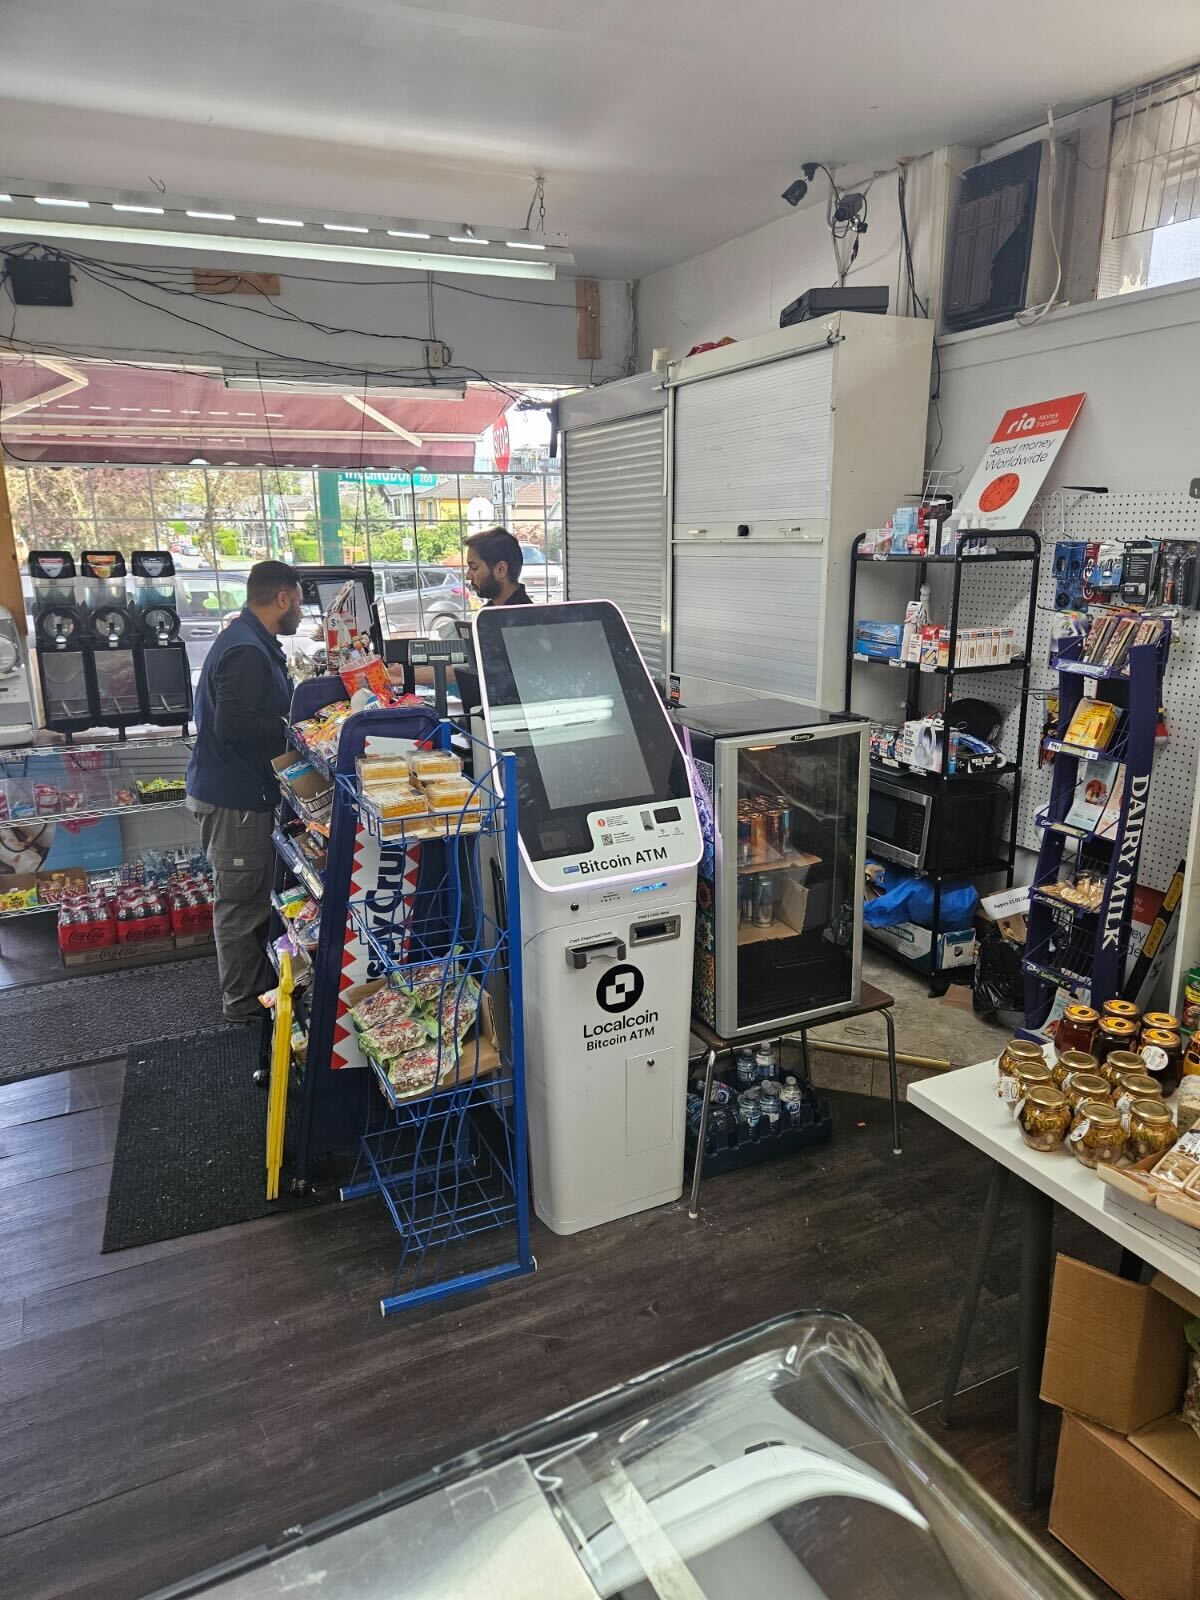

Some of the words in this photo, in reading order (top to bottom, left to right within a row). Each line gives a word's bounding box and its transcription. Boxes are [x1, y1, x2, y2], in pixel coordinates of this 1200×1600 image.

[1006, 412, 1036, 434] ria
[1036, 419, 1060, 428] Transfer
[1039, 412, 1060, 420] Money
[494, 425, 509, 457] STOP
[990, 443, 1018, 457] Send
[1018, 438, 1056, 452] money
[985, 451, 1048, 471] Worldwide
[419, 474, 433, 483] 200
[1119, 774, 1150, 866] DAIRY
[579, 854, 632, 874] Bitcoin
[635, 847, 668, 864] ATM
[1102, 871, 1131, 950] MILK
[69, 927, 105, 942] Coca-Cola
[126, 925, 161, 940] Coca-Cola
[583, 1010, 659, 1038] Localcoin
[587, 1034, 627, 1051] Bitcoin
[630, 1026, 655, 1041] ATM
